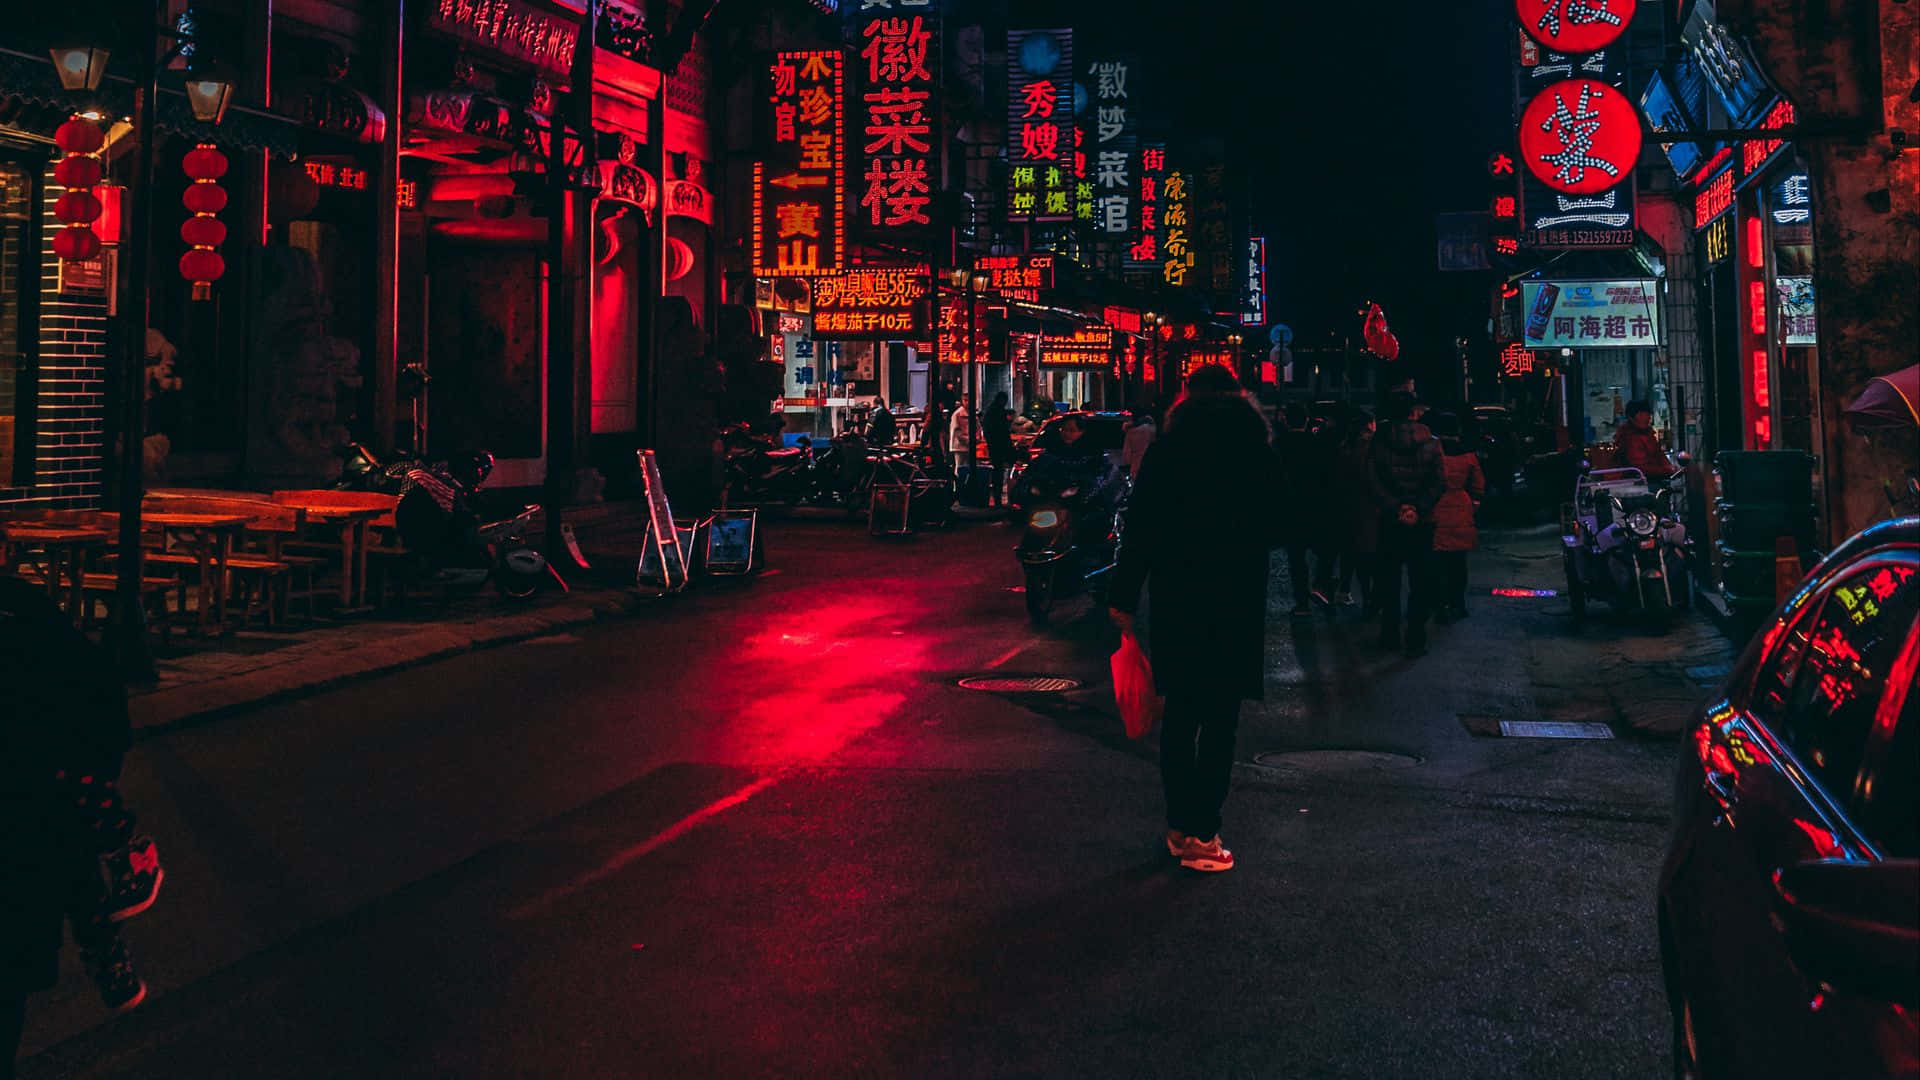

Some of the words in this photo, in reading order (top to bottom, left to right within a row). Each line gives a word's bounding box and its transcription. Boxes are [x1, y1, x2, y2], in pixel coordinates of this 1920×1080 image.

[861, 15, 931, 225] 徽菜楼
[1020, 79, 1059, 161] 秀嫂
[775, 201, 823, 271] 黄山
[815, 312, 913, 332] 酱爆茄子10元
[1553, 315, 1650, 339] 阿海超市
